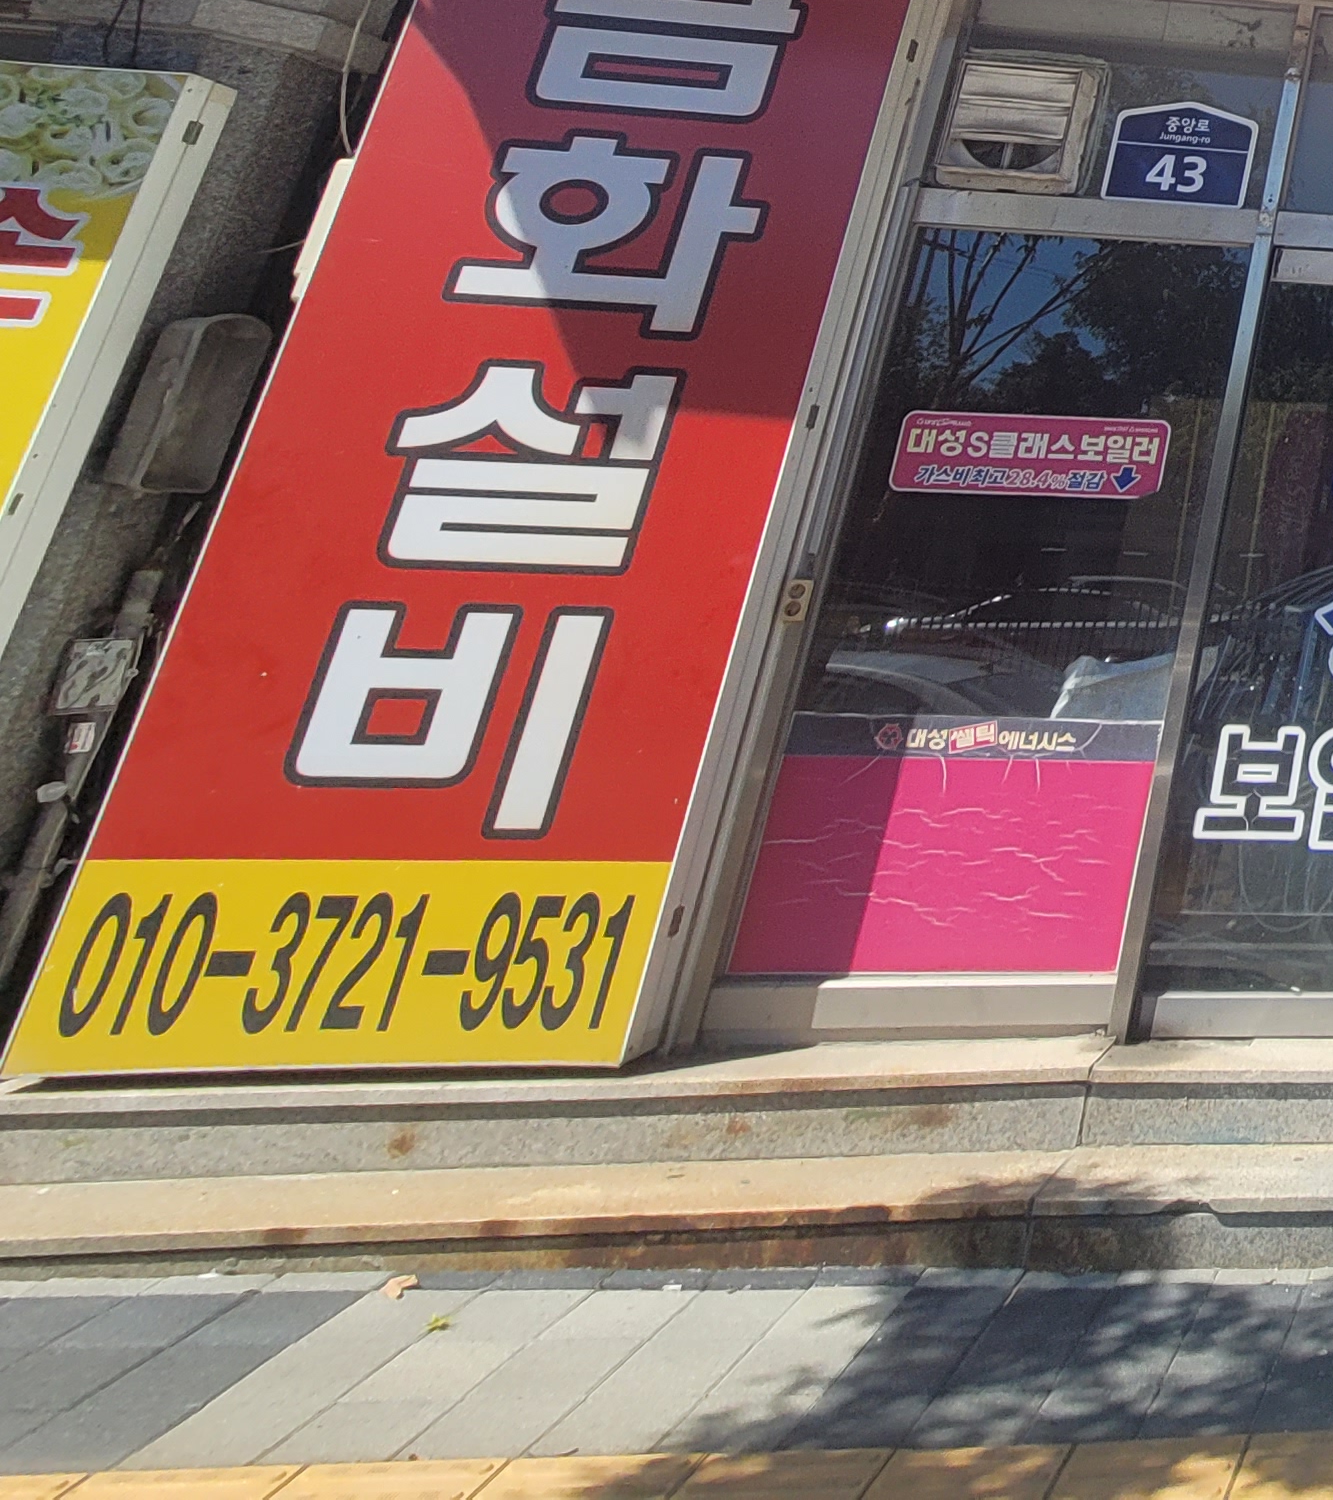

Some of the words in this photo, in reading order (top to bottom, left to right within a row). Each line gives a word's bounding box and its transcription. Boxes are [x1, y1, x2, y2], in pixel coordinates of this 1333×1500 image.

[1160, 131, 1211, 145] Jungang-ro
[1165, 116, 1210, 134] 중앙로
[1145, 154, 1208, 193] 43
[58, 891, 636, 1039] 010-3721-9531
